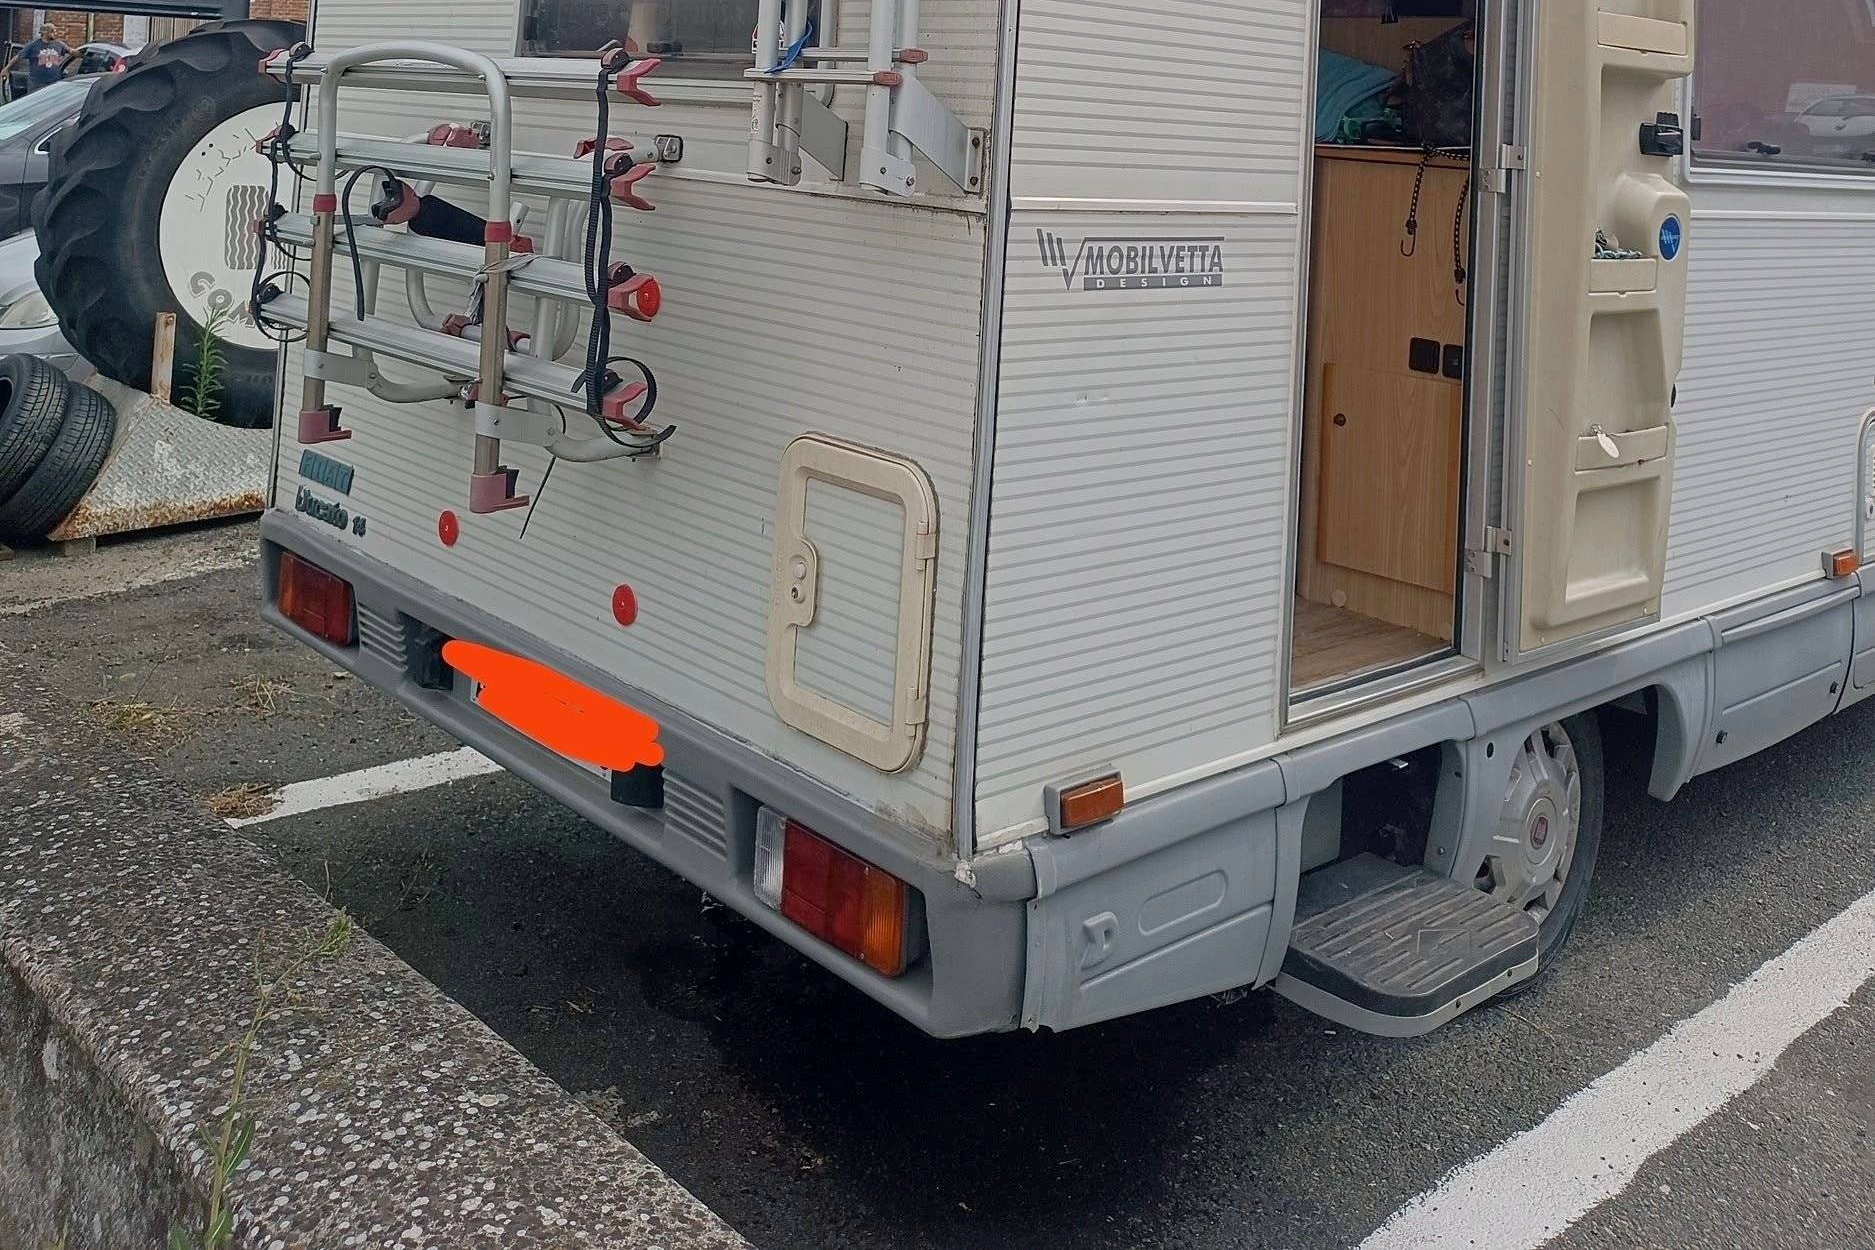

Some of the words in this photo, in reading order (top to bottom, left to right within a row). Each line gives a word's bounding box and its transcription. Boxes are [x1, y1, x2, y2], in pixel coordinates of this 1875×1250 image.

[1084, 244, 1224, 275] MOBILVETTA
[1096, 276, 1212, 289] DESIGN
[301, 450, 352, 494] FIAT
